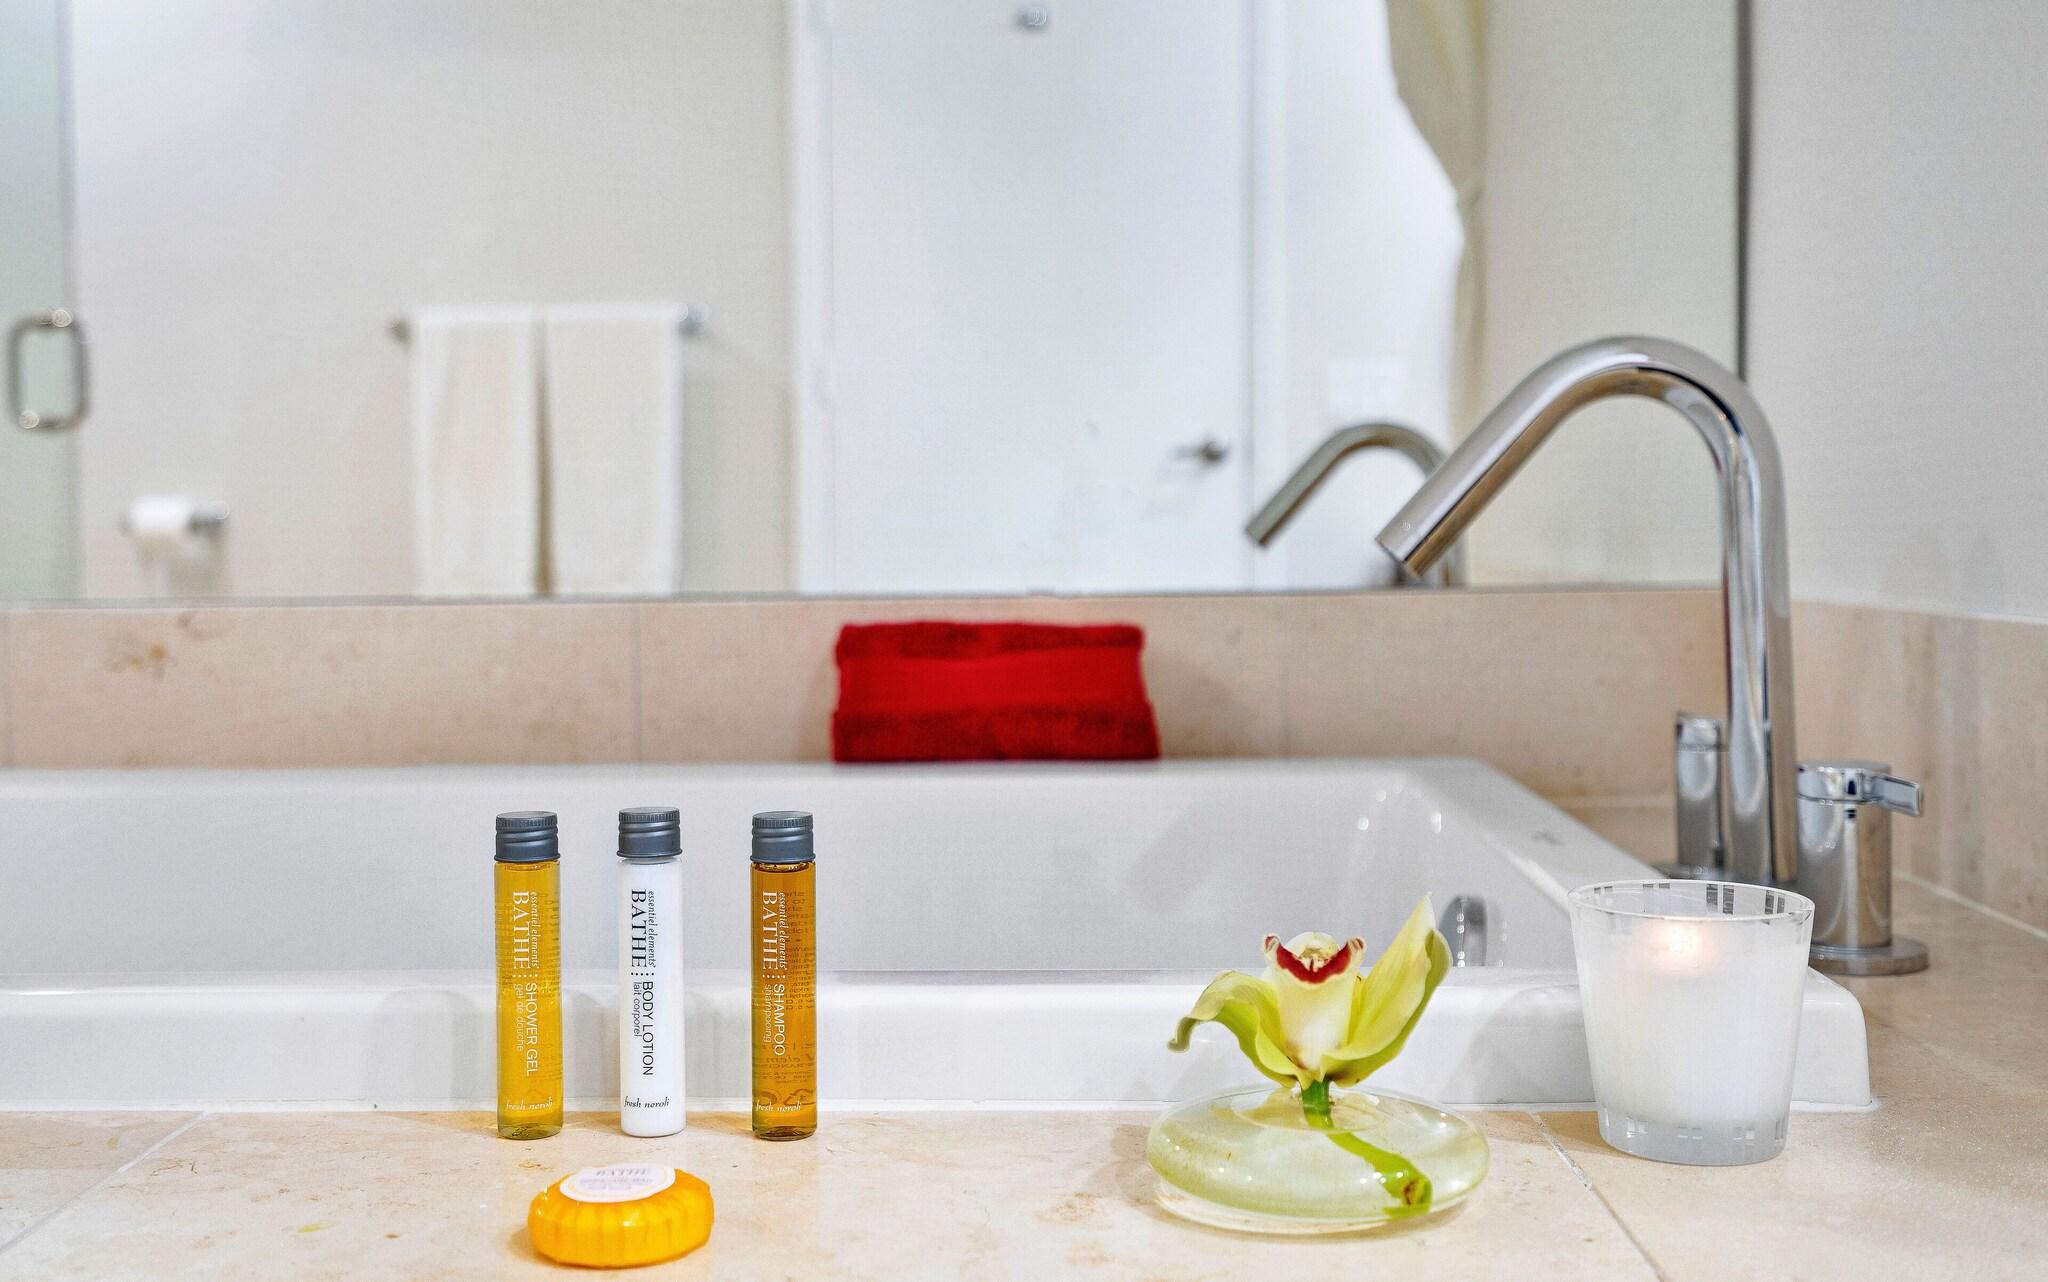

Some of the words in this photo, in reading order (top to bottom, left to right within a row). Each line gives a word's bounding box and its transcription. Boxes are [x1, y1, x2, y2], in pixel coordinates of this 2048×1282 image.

[530, 892, 541, 926] essentiel
[648, 891, 658, 926] essentiel
[778, 893, 789, 928] essentiel
[512, 892, 530, 969] BATHE
[631, 890, 647, 967] BATHE
[762, 892, 778, 969] BATHE
[515, 984, 526, 998] gel
[634, 982, 642, 995] lait
[642, 982, 653, 1020] BODY
[516, 1001, 526, 1013] de
[526, 982, 538, 1045] SHOWER
[632, 998, 642, 1037] corporel
[764, 984, 773, 1043] shampooing
[773, 984, 785, 1056] SHAMPOO
[516, 1017, 526, 1051] douche
[642, 1024, 653, 1076] LOTION
[526, 1049, 538, 1076] GEL
[624, 1096, 641, 1108] fresh
